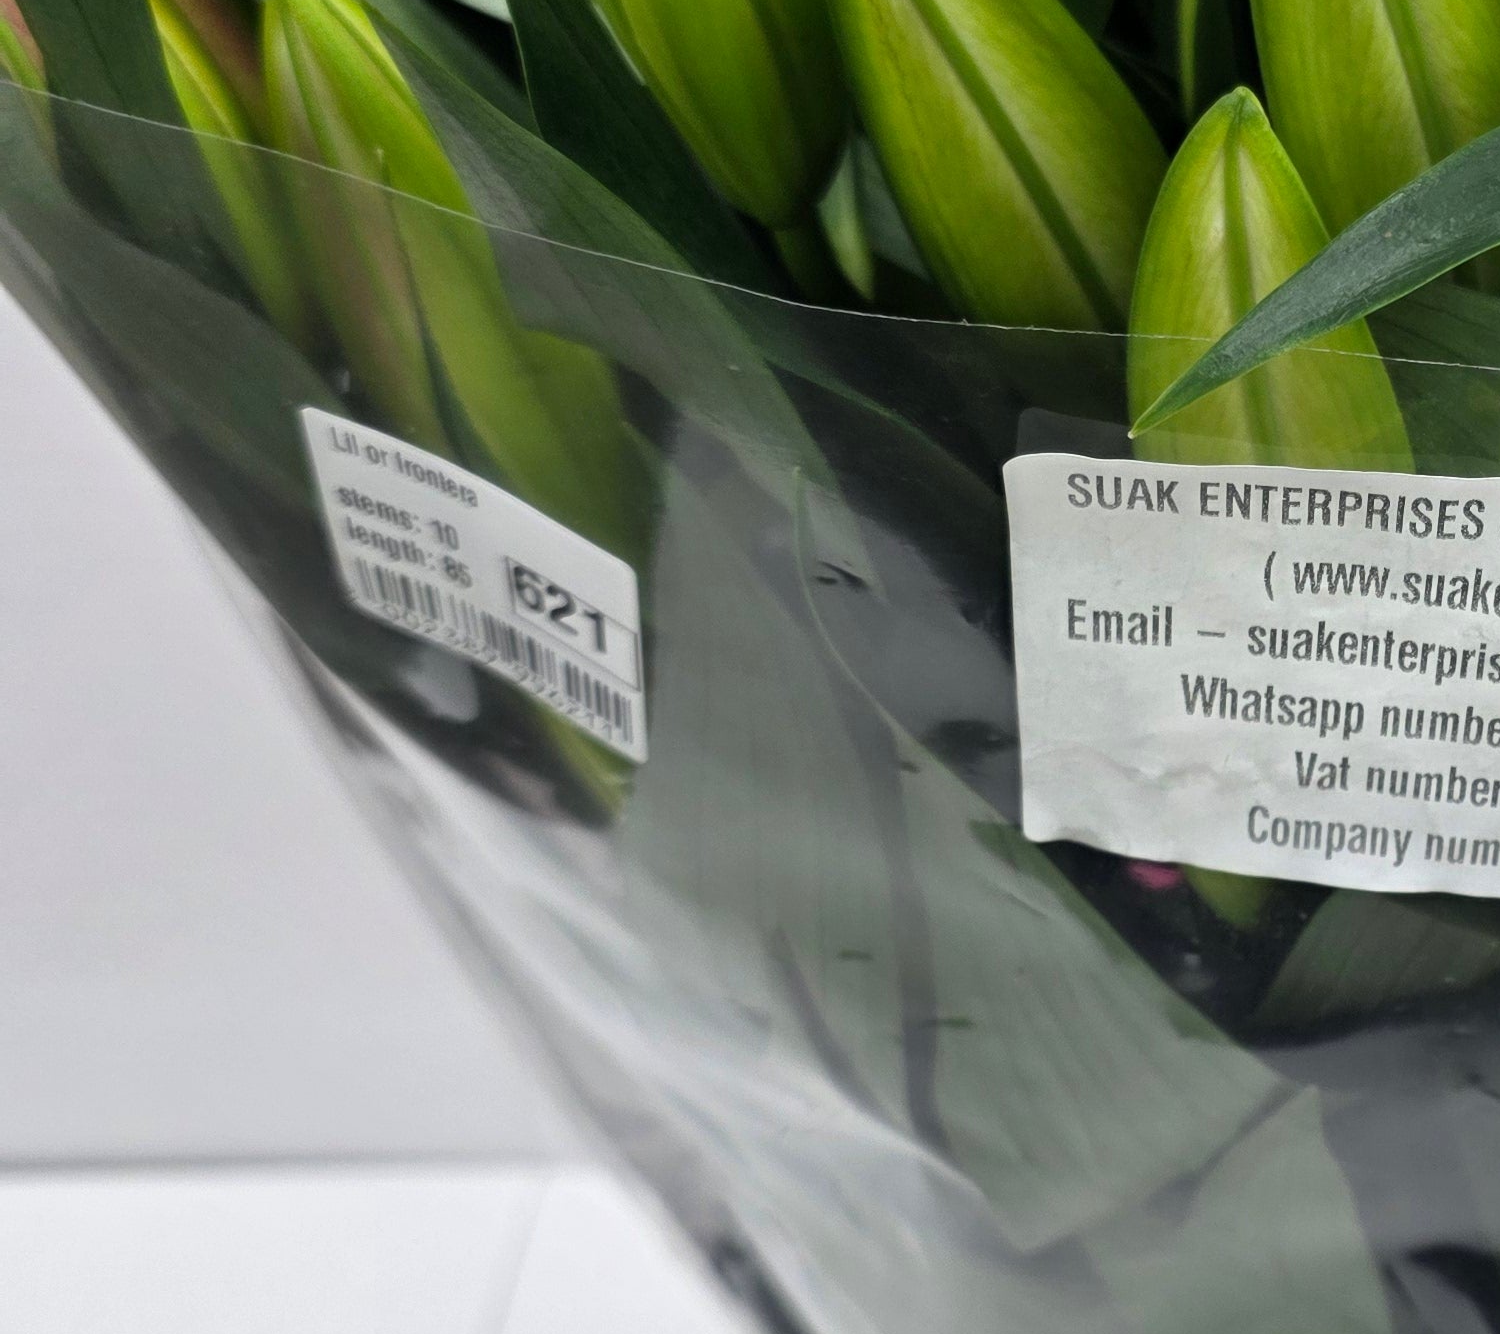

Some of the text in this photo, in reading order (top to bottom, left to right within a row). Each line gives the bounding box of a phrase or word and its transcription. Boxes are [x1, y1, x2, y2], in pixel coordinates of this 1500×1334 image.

[337, 486, 460, 551] stems: 10
[1066, 473, 1180, 515] SUAK
[1199, 480, 1487, 541] ENTERPRISES
[345, 516, 436, 571] length:
[513, 565, 607, 654] 621
[1066, 598, 1174, 648] Email
[1180, 673, 1365, 741] Whatsapp
[1294, 750, 1351, 792] Vat
[1247, 804, 1413, 867] Company
